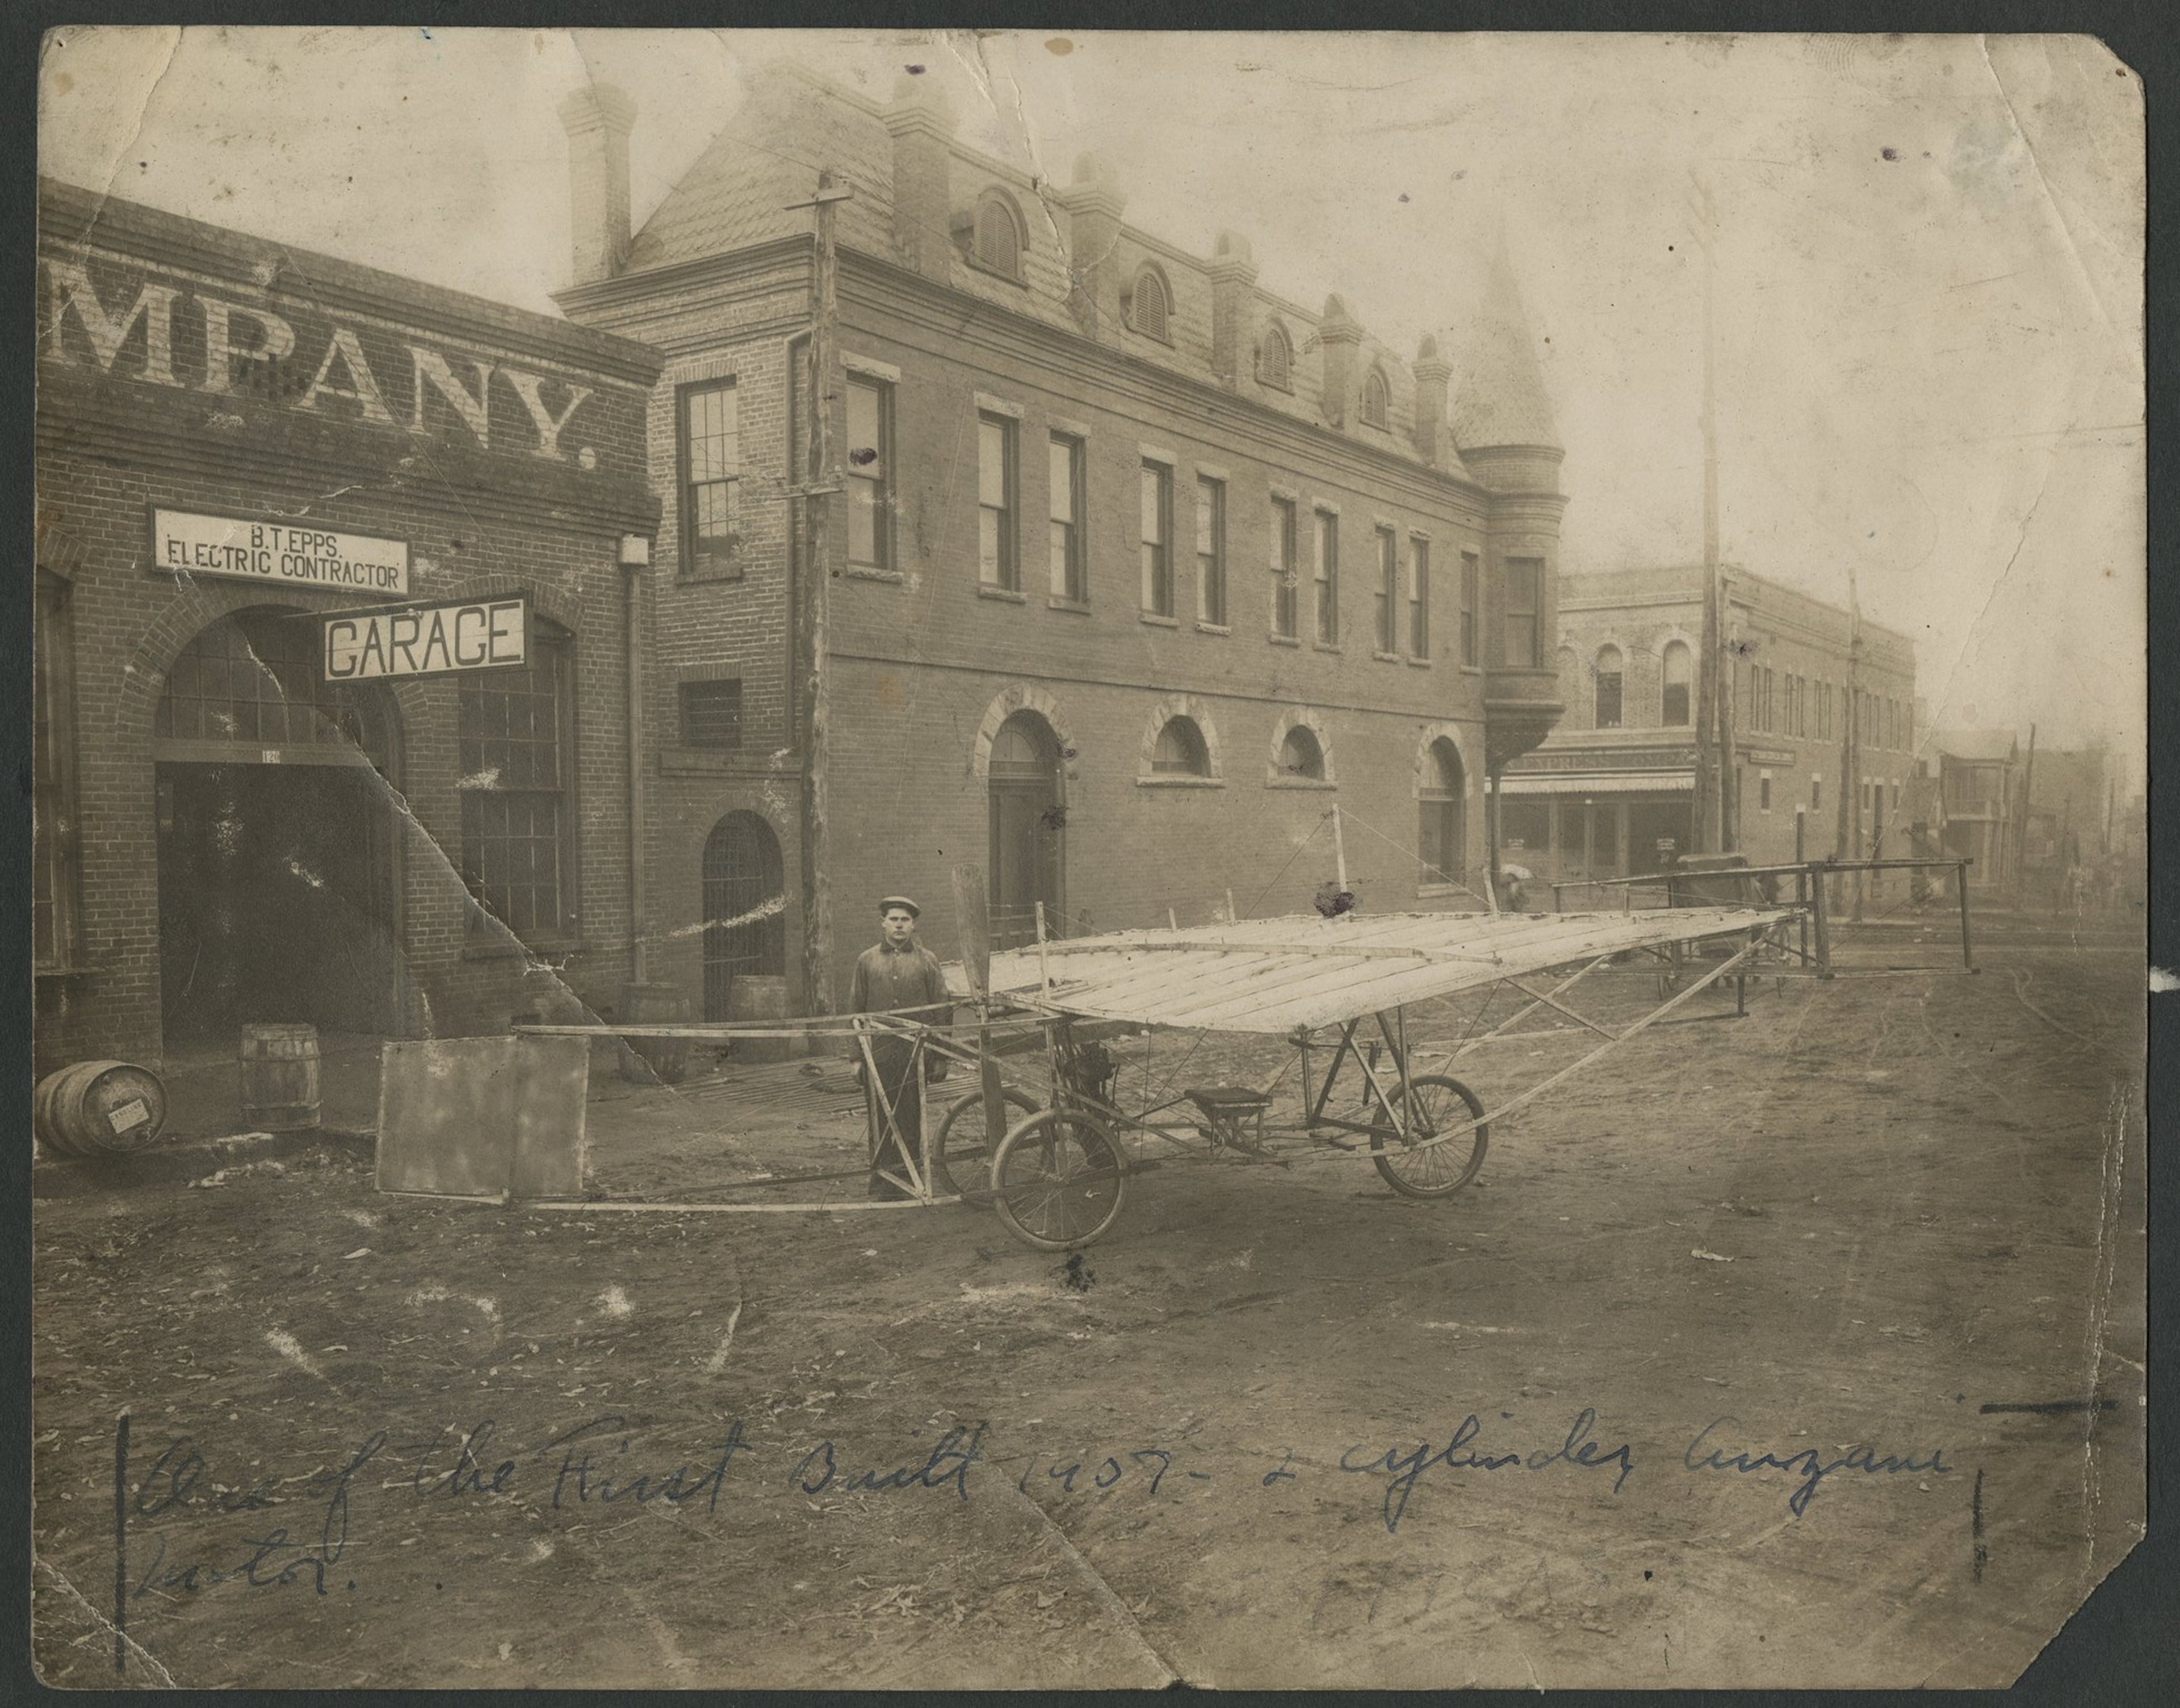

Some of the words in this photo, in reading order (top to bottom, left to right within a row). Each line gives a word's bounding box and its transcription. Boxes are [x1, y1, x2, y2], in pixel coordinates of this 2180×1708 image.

[35, 257, 596, 470] MPANY.
[167, 539, 271, 574] ELECTRIC
[280, 553, 399, 589] CONTRACTOR
[328, 601, 521, 678] GARAGE
[309, 1429, 388, 1566] of
[393, 1419, 515, 1497] the
[793, 1420, 990, 1501] Built
[1262, 1445, 1297, 1487] 2
